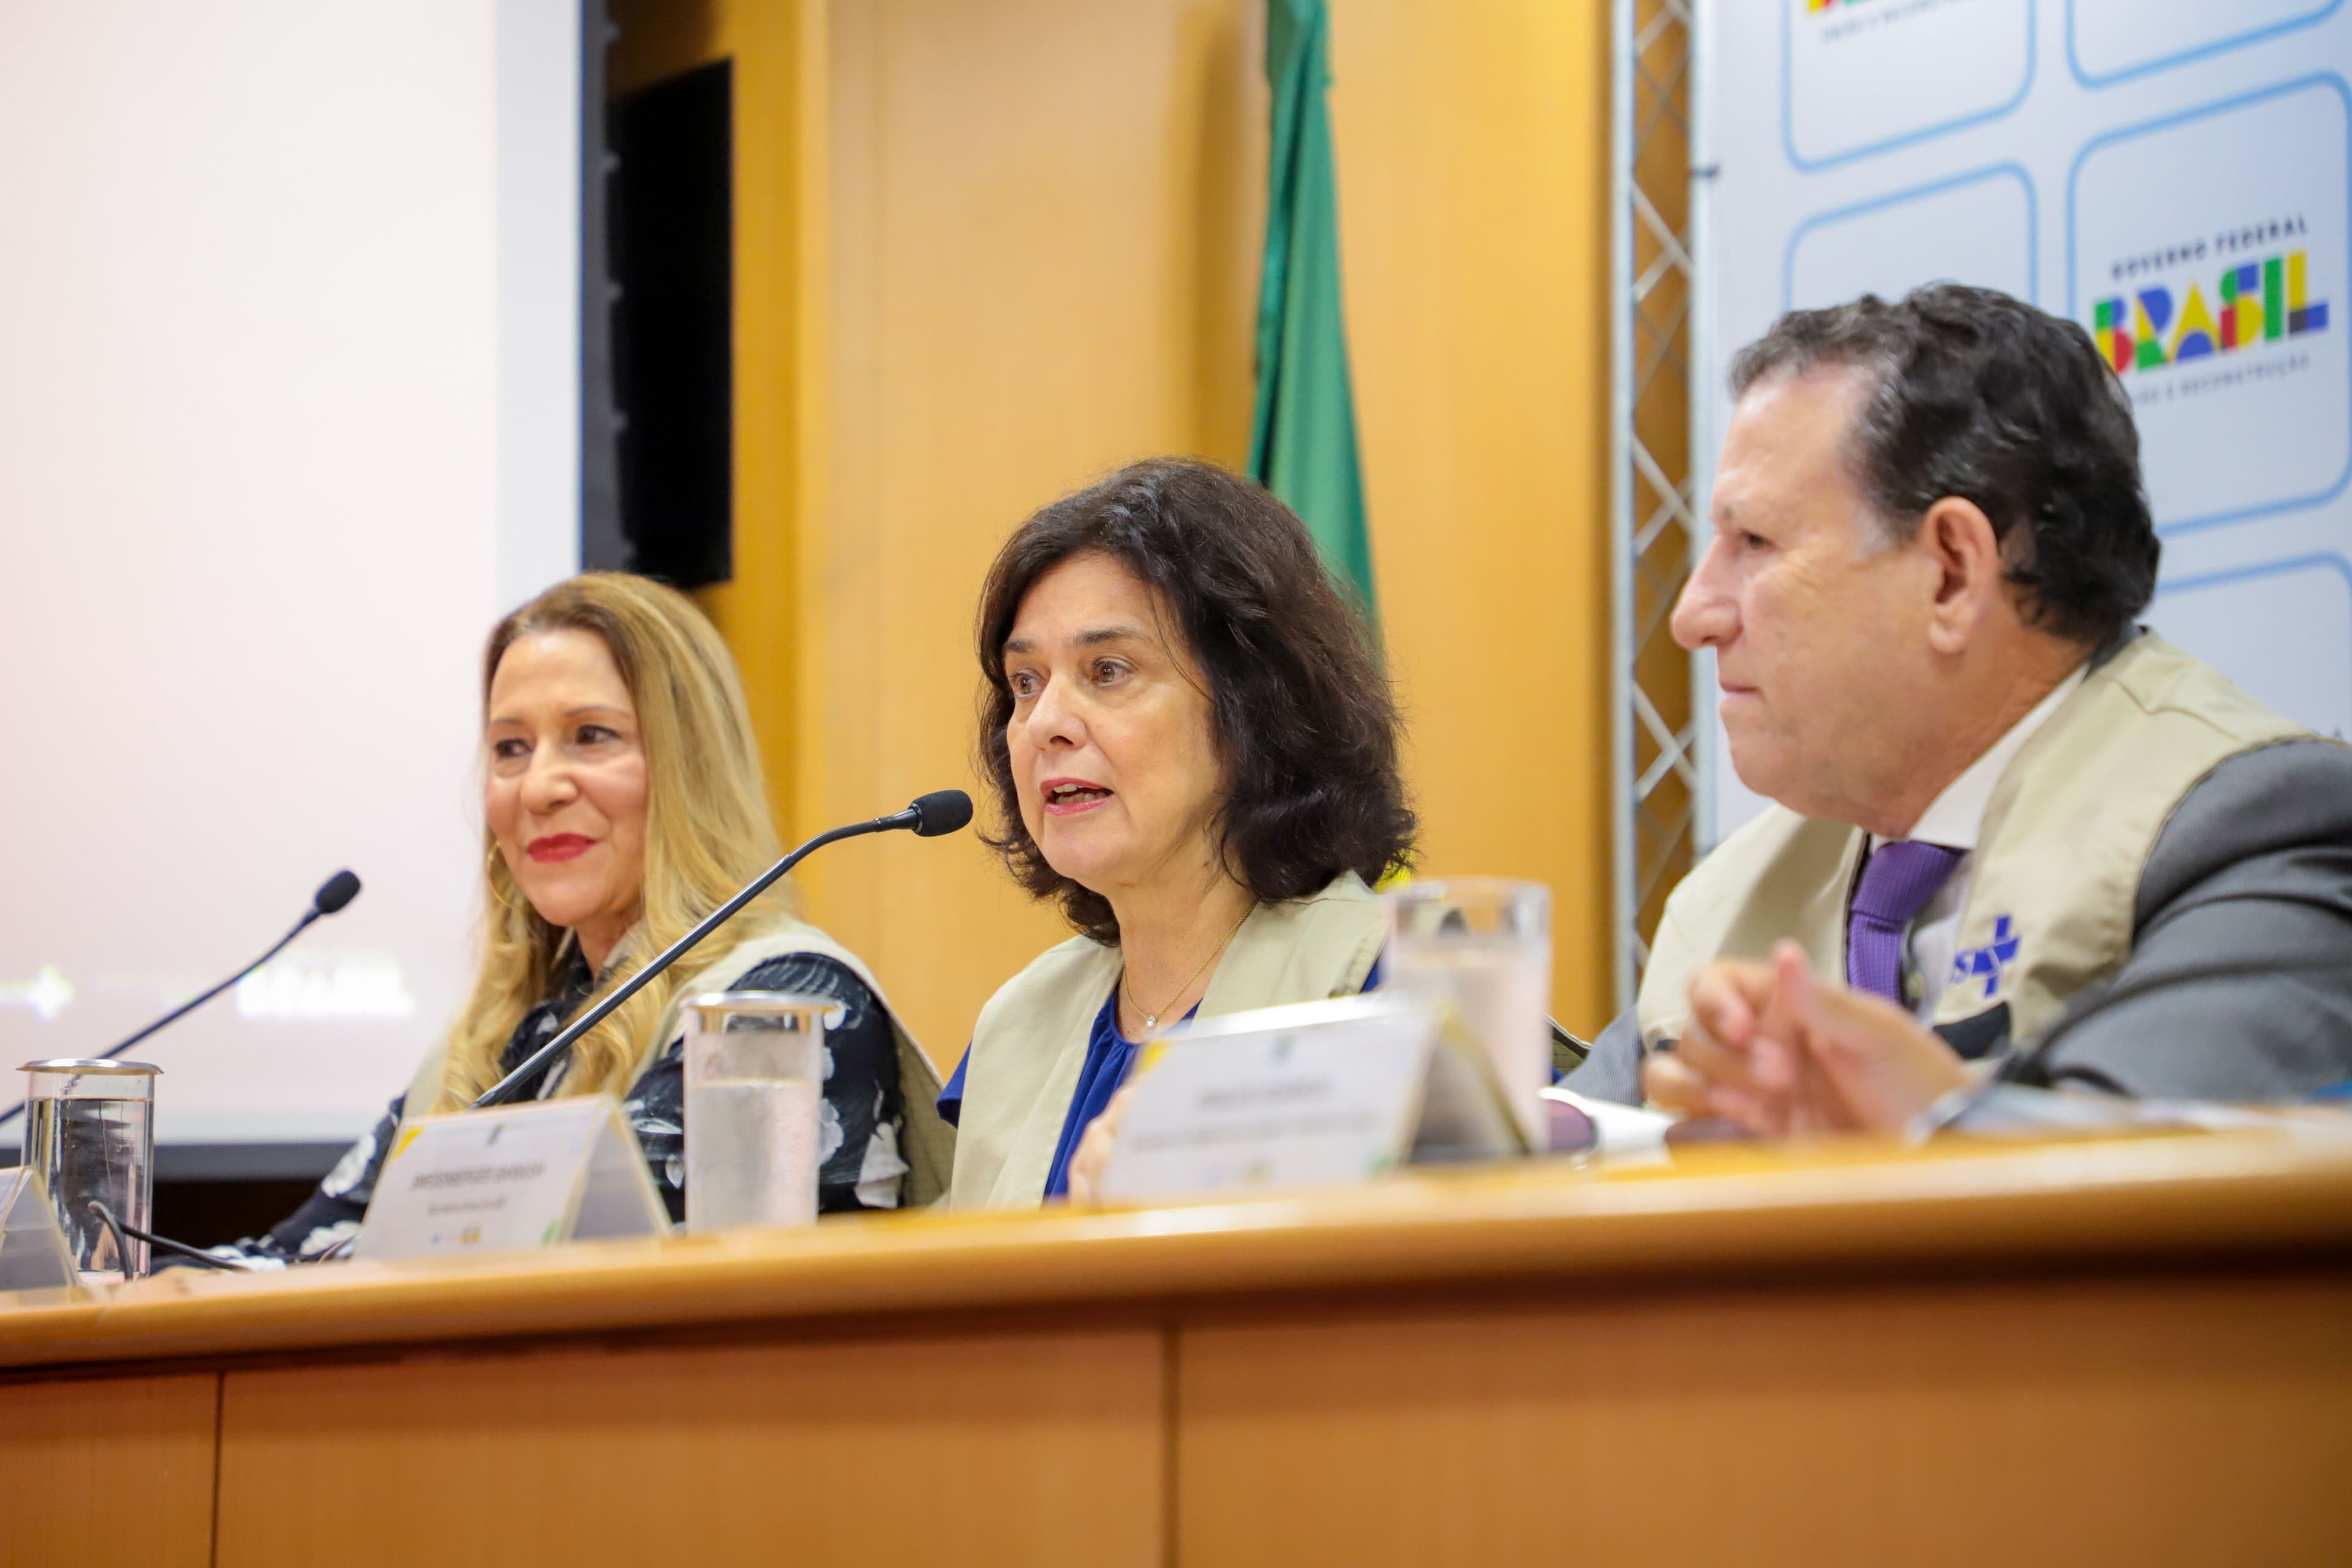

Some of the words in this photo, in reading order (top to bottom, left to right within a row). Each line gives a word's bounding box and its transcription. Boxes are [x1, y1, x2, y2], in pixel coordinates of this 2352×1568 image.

[2111, 237, 2206, 281] GOVERNO
[2215, 214, 2308, 254] FEDERAL
[2094, 250, 2329, 374] BRASIL
